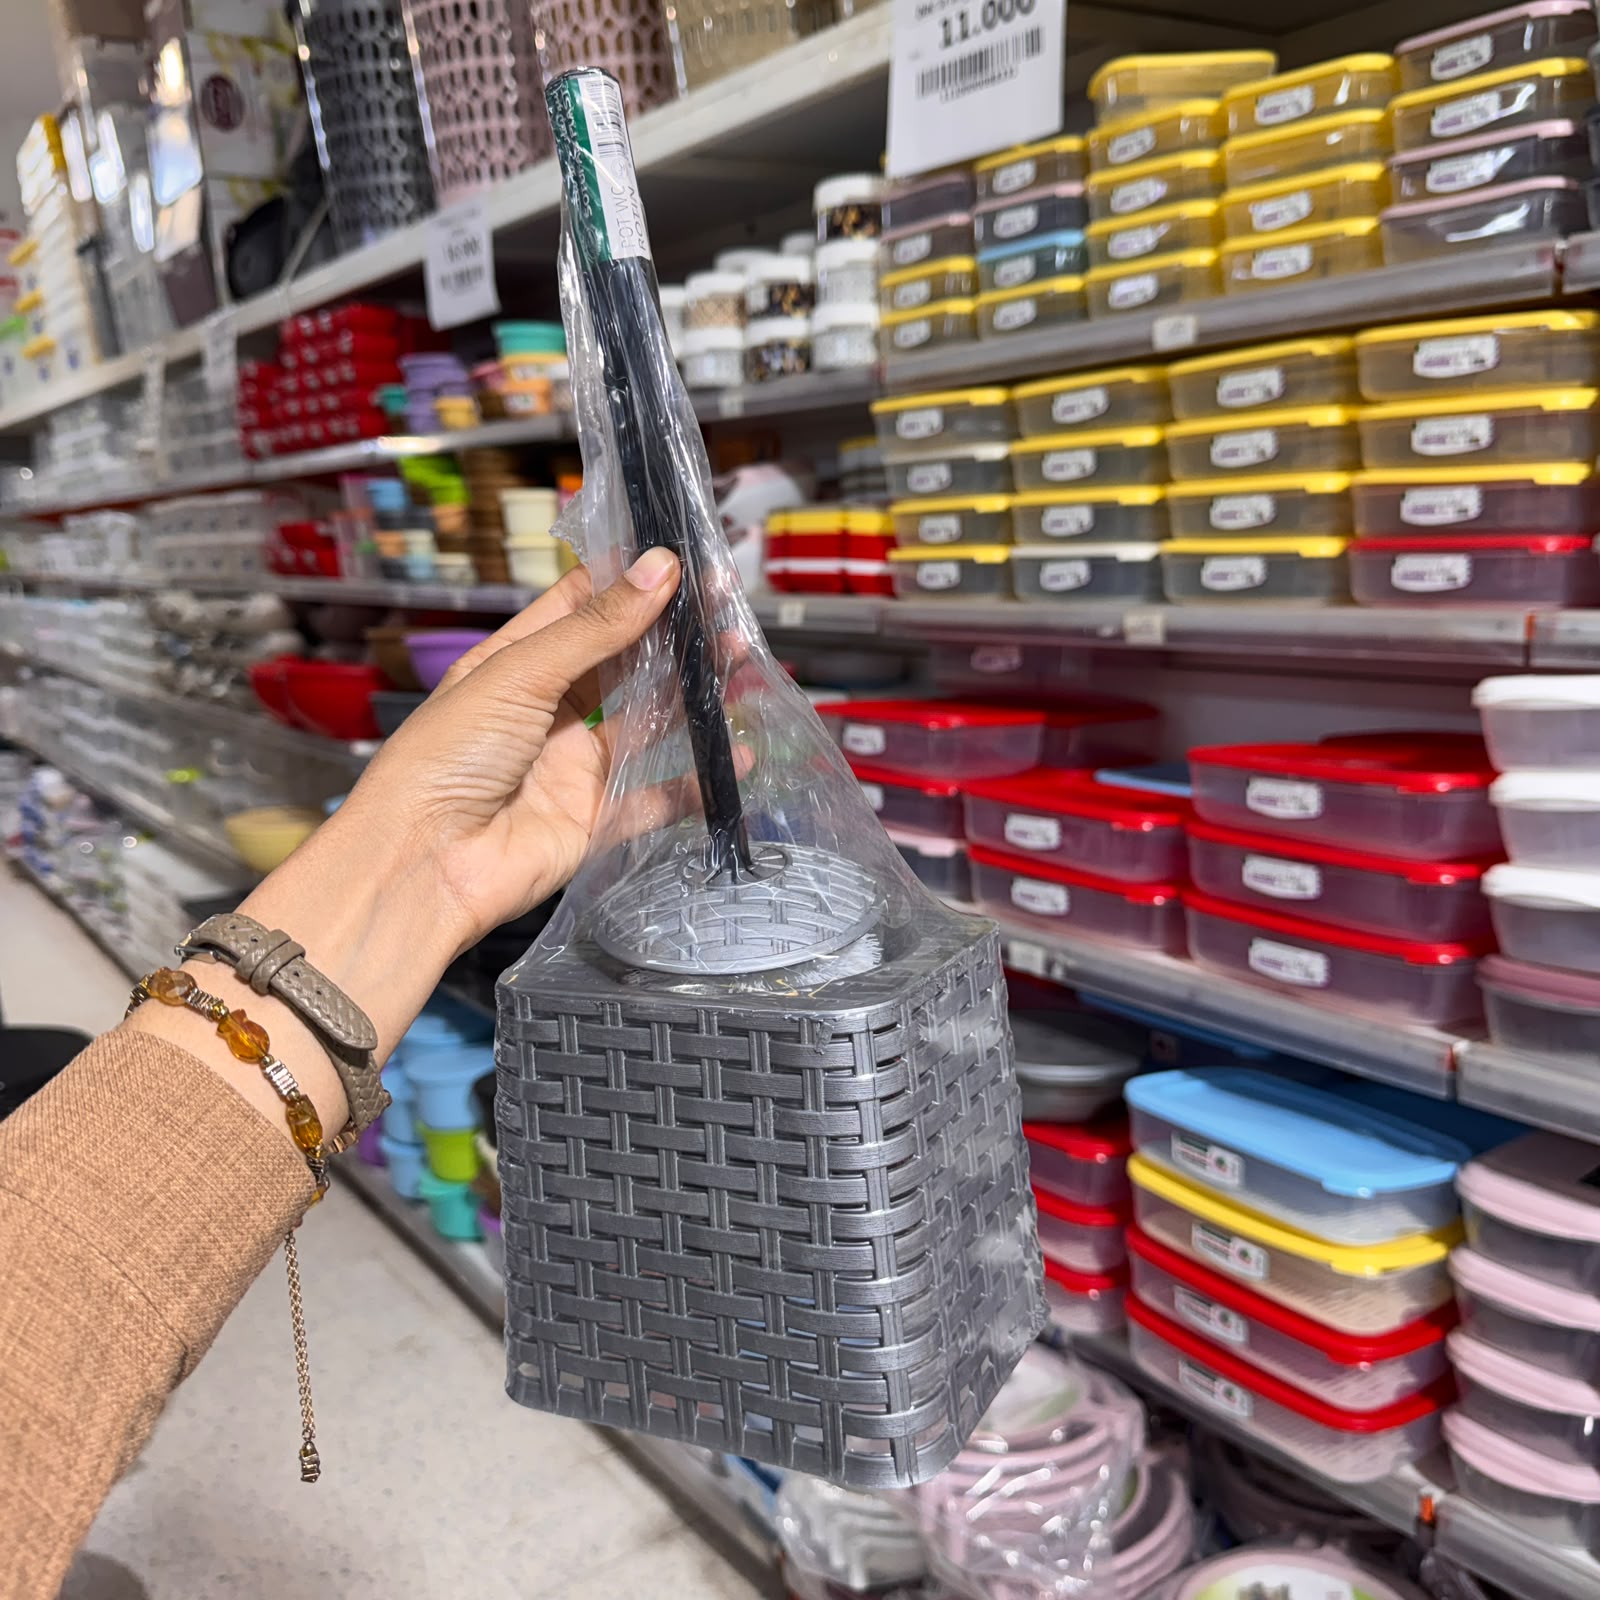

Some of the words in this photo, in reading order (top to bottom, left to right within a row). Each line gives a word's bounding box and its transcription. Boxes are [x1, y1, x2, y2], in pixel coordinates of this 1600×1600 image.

[610, 185, 629, 213] WC
[616, 218, 636, 248] POT
[628, 186, 647, 250] ROTIN
